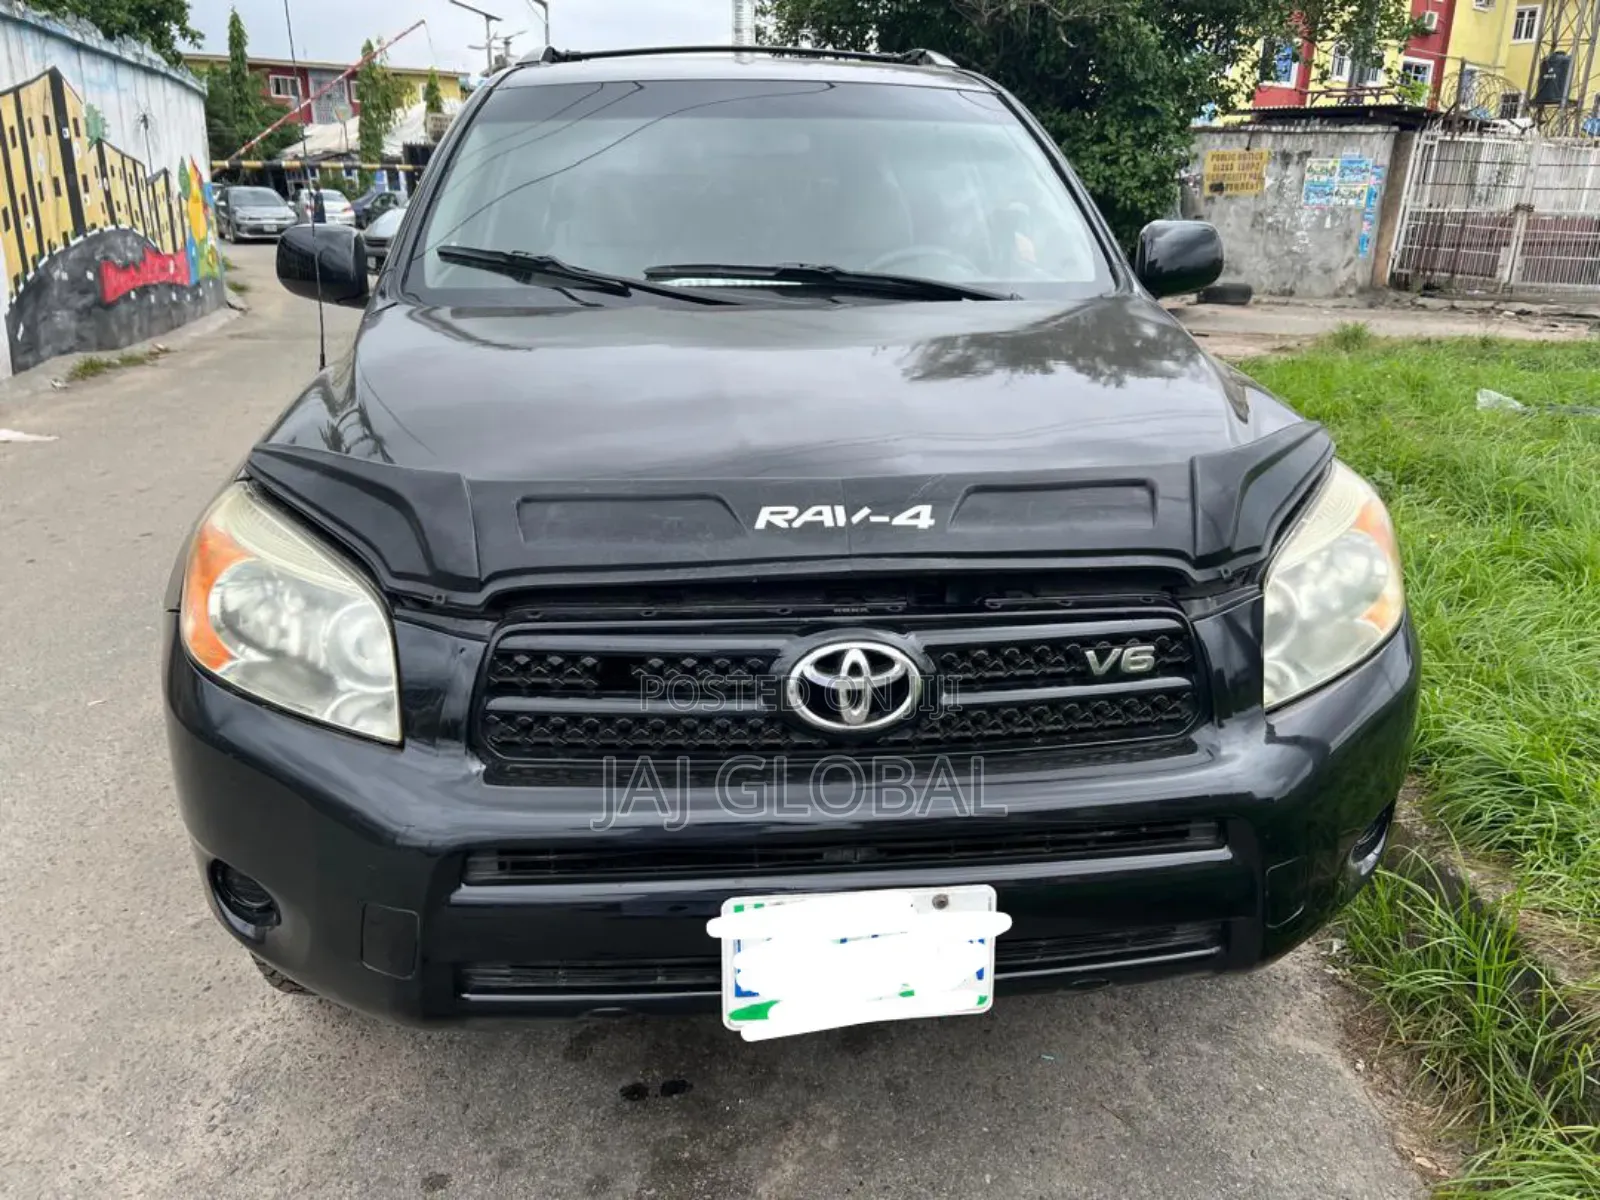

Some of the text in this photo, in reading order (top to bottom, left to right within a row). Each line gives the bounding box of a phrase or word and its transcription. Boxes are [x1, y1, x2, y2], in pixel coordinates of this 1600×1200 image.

[1211, 152, 1264, 162] PUBLIC NOTICE
[754, 504, 936, 530] RAV-4
[1084, 645, 1155, 675] V6
